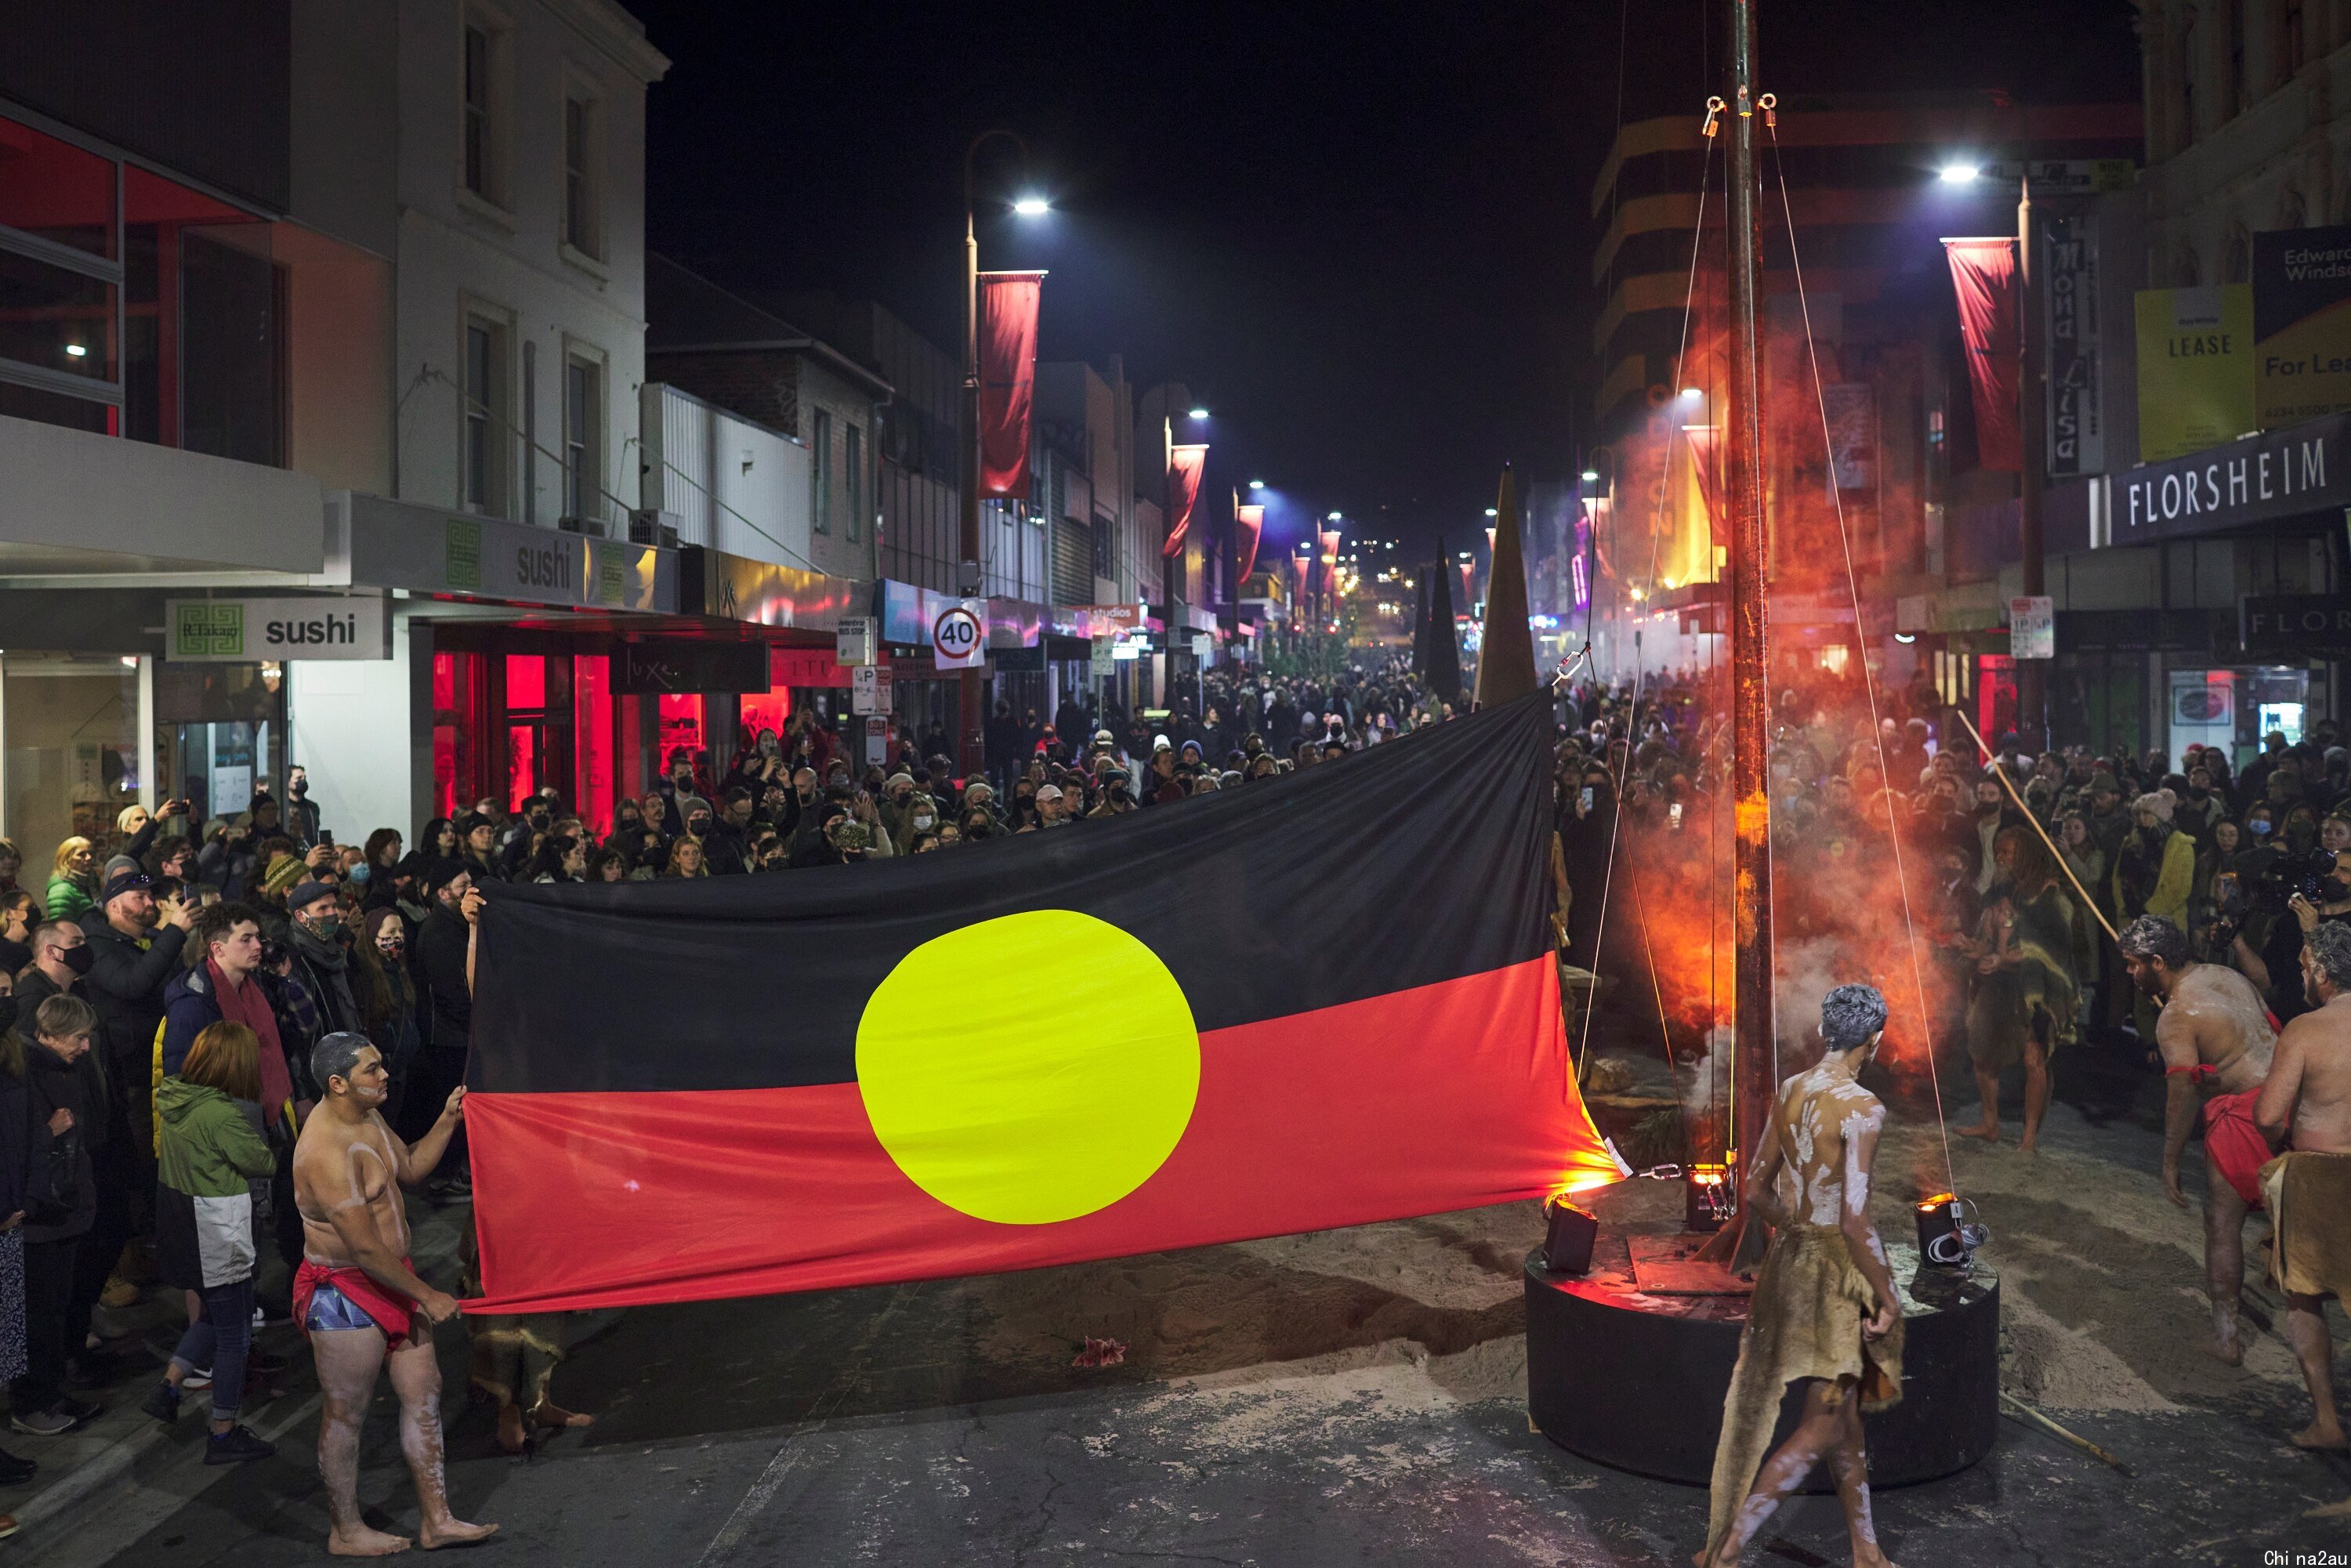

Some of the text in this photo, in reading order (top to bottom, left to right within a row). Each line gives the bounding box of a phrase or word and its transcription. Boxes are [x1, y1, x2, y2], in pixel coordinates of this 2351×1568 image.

[2168, 334, 2232, 357] LEASE
[2265, 357, 2306, 376] For
[2129, 438, 2327, 527] FLORSHEIM
[517, 541, 571, 589] sushi
[1092, 607, 1131, 617] studios
[266, 614, 355, 643] sushi
[940, 622, 973, 644] 40
